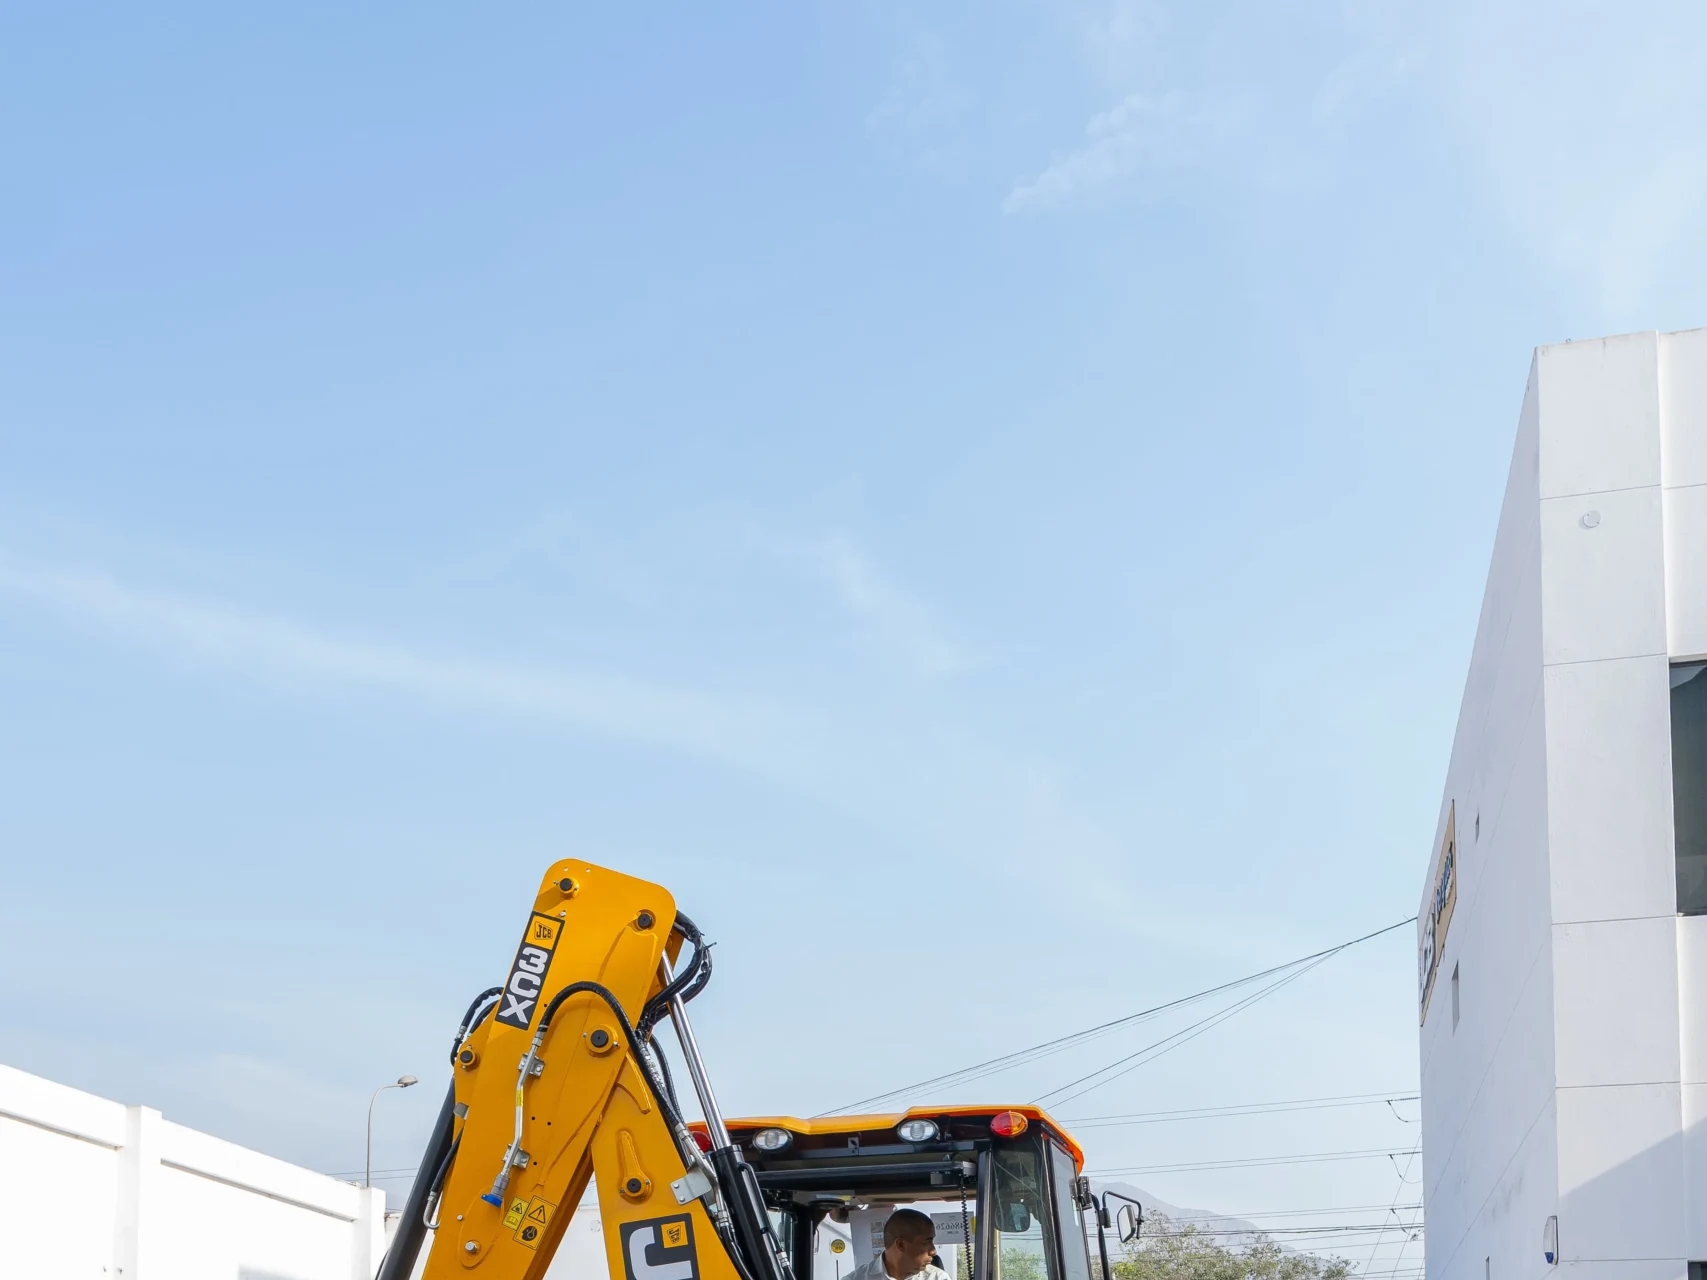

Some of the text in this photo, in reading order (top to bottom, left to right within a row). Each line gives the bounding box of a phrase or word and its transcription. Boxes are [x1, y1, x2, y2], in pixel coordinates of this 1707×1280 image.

[535, 924, 552, 939] JCB
[498, 947, 548, 1024] 3CX
[667, 1225, 682, 1244] JCB
